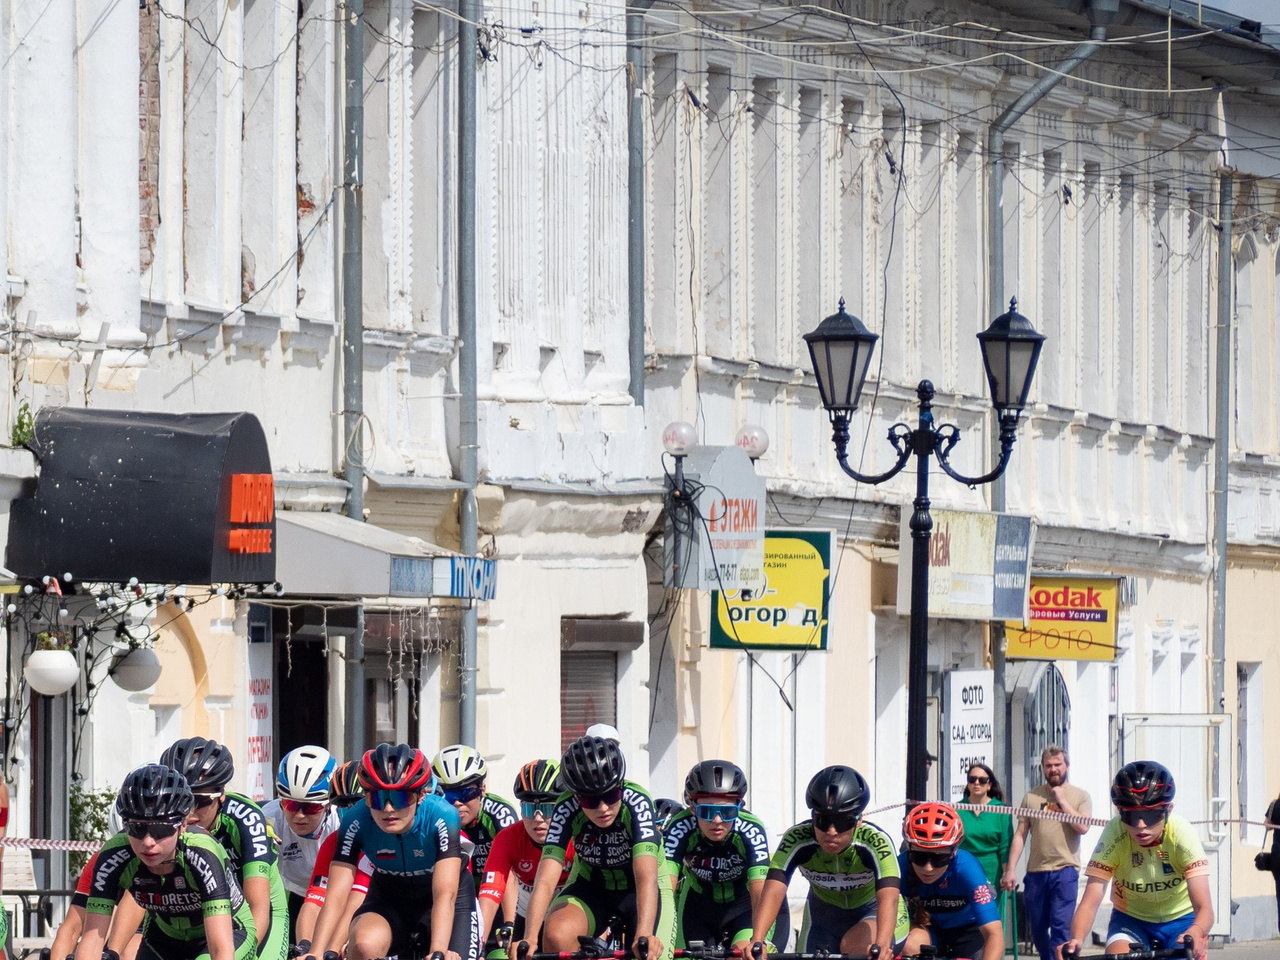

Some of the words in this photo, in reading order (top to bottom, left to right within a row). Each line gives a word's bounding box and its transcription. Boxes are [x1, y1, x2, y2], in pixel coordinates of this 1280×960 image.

[764, 552, 816, 560] ЗИРОВАННЫЙ
[928, 521, 951, 568] dak
[1030, 609, 1066, 619] фровые
[1069, 609, 1101, 620] Услуги
[1018, 627, 1093, 650] ФОТО
[961, 685, 984, 705] ФОТО
[952, 725, 965, 744] САД
[970, 723, 992, 742] ОГОРОД
[226, 799, 268, 858] RUSSIA
[623, 789, 655, 839] RUSSIA
[341, 819, 360, 856] MAIKOP
[435, 817, 449, 852] MAIKOP
[665, 816, 698, 858] RUSSIA
[734, 817, 769, 862] RUSSIA
[779, 828, 812, 854] RUSS
[94, 848, 131, 892] MICHE
[185, 848, 218, 895] MICHE
[134, 885, 202, 906] ESTRORETS
